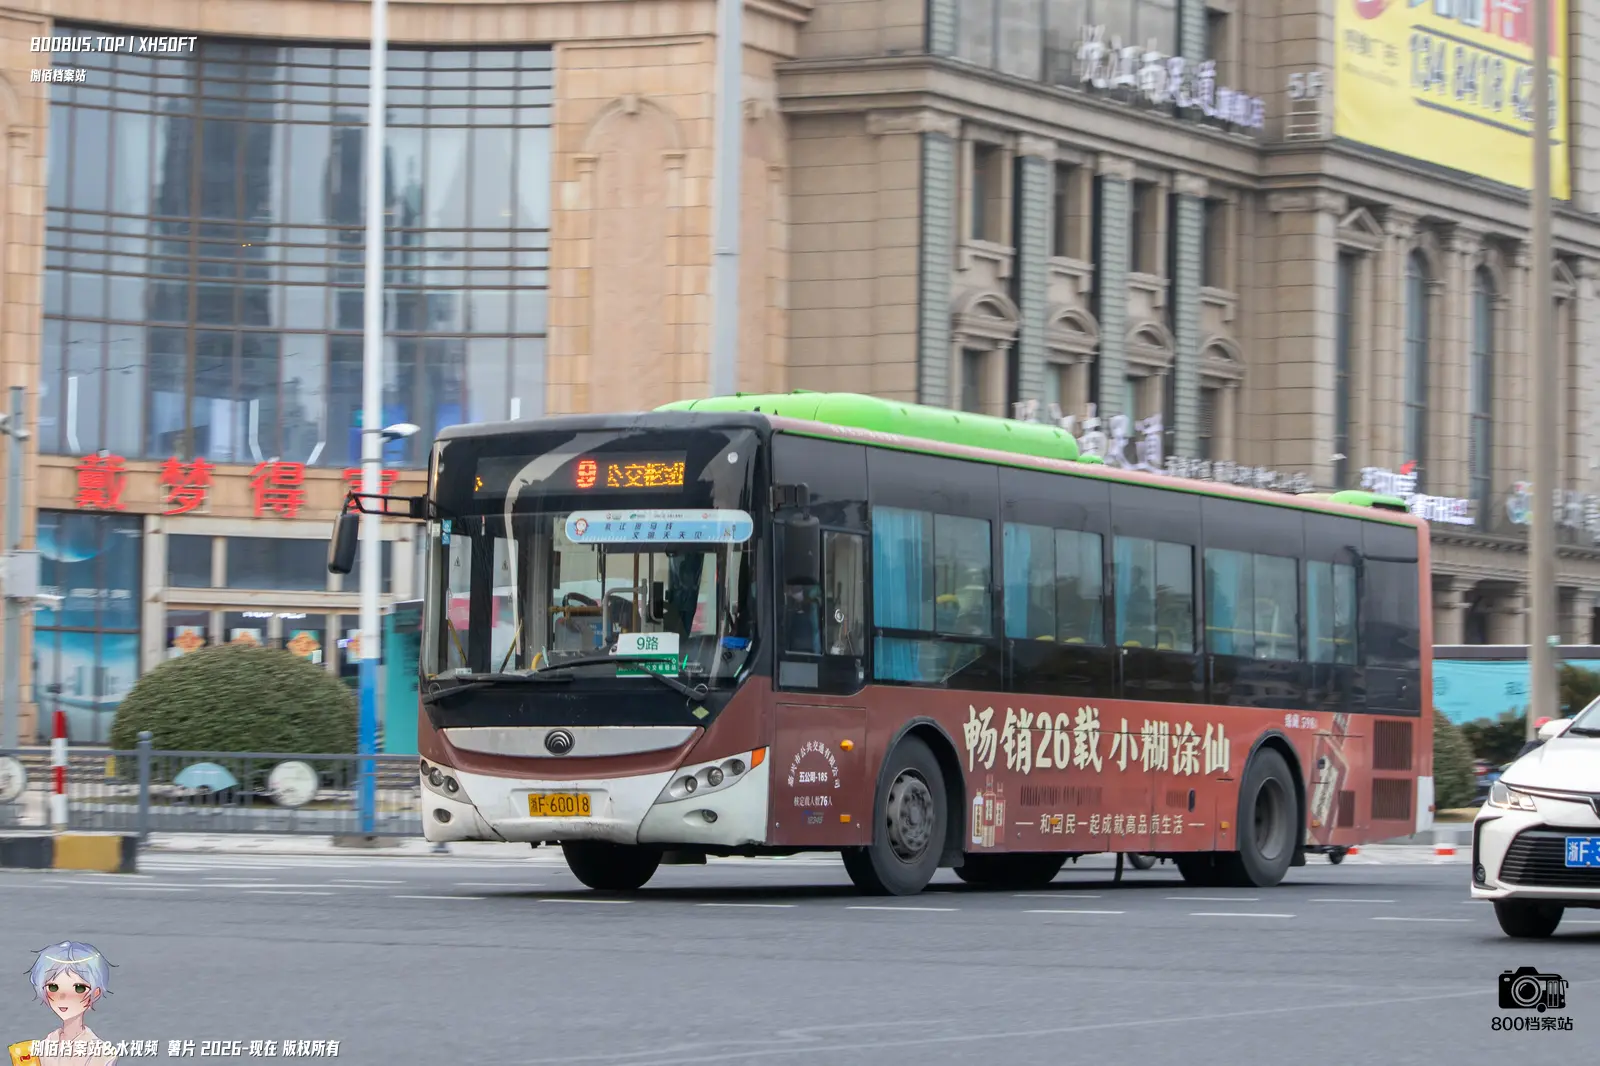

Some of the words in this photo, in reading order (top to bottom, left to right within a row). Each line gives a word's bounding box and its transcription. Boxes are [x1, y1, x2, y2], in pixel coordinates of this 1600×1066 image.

[576, 460, 597, 488] 9
[636, 636, 659, 651] 9路
[963, 705, 1103, 775] 畅销26载
[1109, 717, 1231, 776] 小糊涂仙
